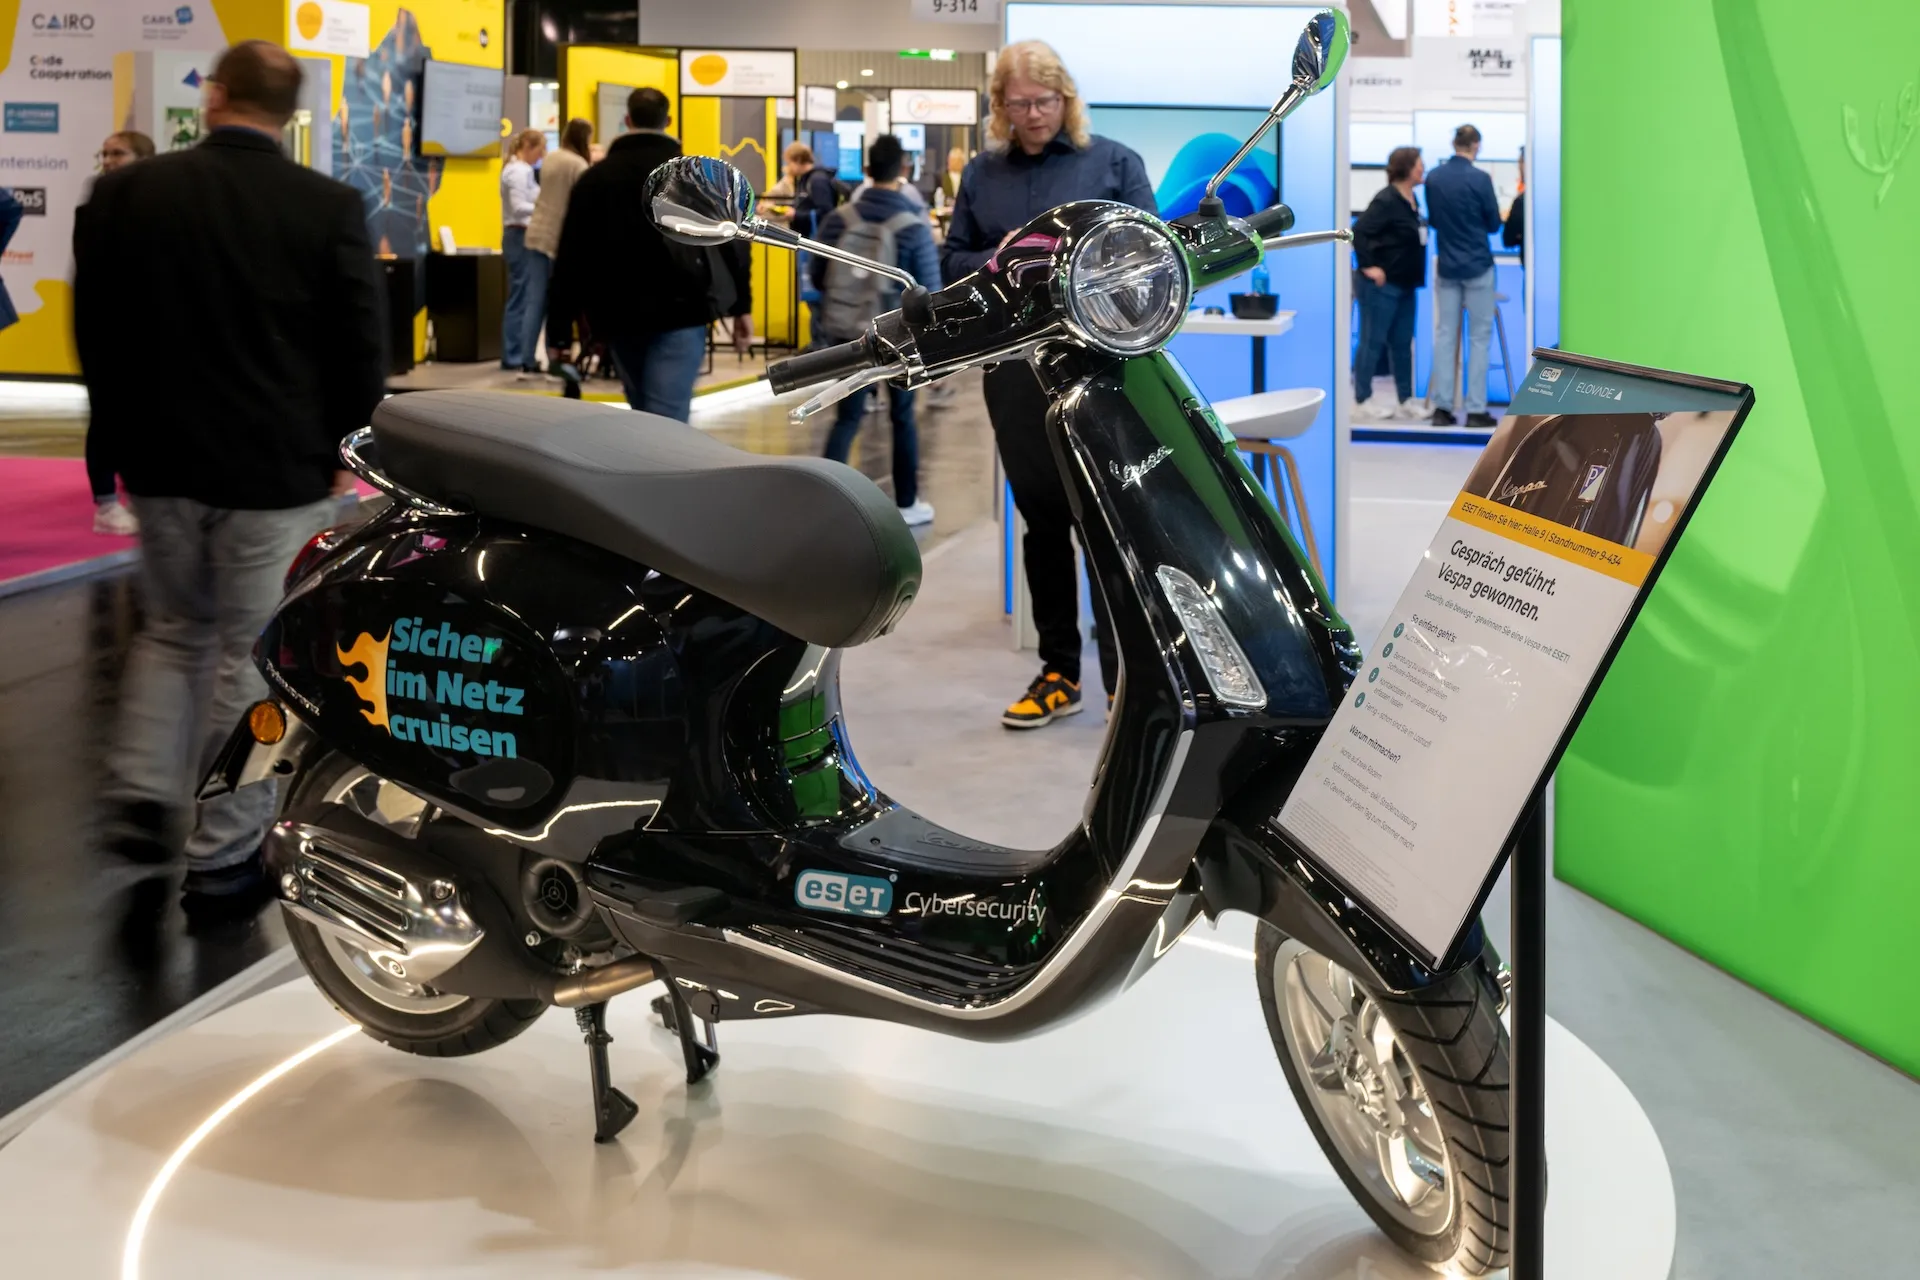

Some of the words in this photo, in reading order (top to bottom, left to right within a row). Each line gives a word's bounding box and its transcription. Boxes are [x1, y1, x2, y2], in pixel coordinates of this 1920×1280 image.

[31, 12, 95, 31] CAIRO
[932, 0, 978, 13] 9-314
[29, 54, 64, 67] Code
[29, 68, 113, 82] Cooperation
[1462, 503, 1479, 514] ESET
[1477, 508, 1497, 521] finden
[1497, 515, 1507, 525] Sie
[1508, 519, 1522, 531] hier:
[1522, 525, 1539, 537] Halle
[1539, 530, 1546, 538] 9
[1549, 533, 1599, 558] Standnummer
[1599, 551, 1622, 566] 9-434
[1451, 540, 1505, 574] Gespräch
[1503, 565, 1556, 596] geführt.
[1439, 562, 1472, 590] Vespa
[1470, 582, 1538, 621] gewonnen.
[391, 617, 502, 664] Sicher
[1411, 614, 1419, 623] So
[1419, 619, 1438, 633] einfach
[1425, 590, 1443, 605] Security,
[1453, 604, 1473, 618] bewegt
[1475, 616, 1502, 631] gewinnen
[1502, 626, 1511, 636] Sie
[1511, 632, 1523, 642] eine
[1524, 637, 1541, 650] Vespa
[1541, 646, 1552, 655] mit
[1552, 649, 1570, 663] ESET!
[387, 660, 426, 700] im
[436, 671, 525, 715] Netz
[390, 714, 517, 759] cruisen
[1350, 725, 1368, 742] Warum
[1367, 739, 1401, 763] mitmachen?
[905, 892, 1047, 924] Cybersecurity
